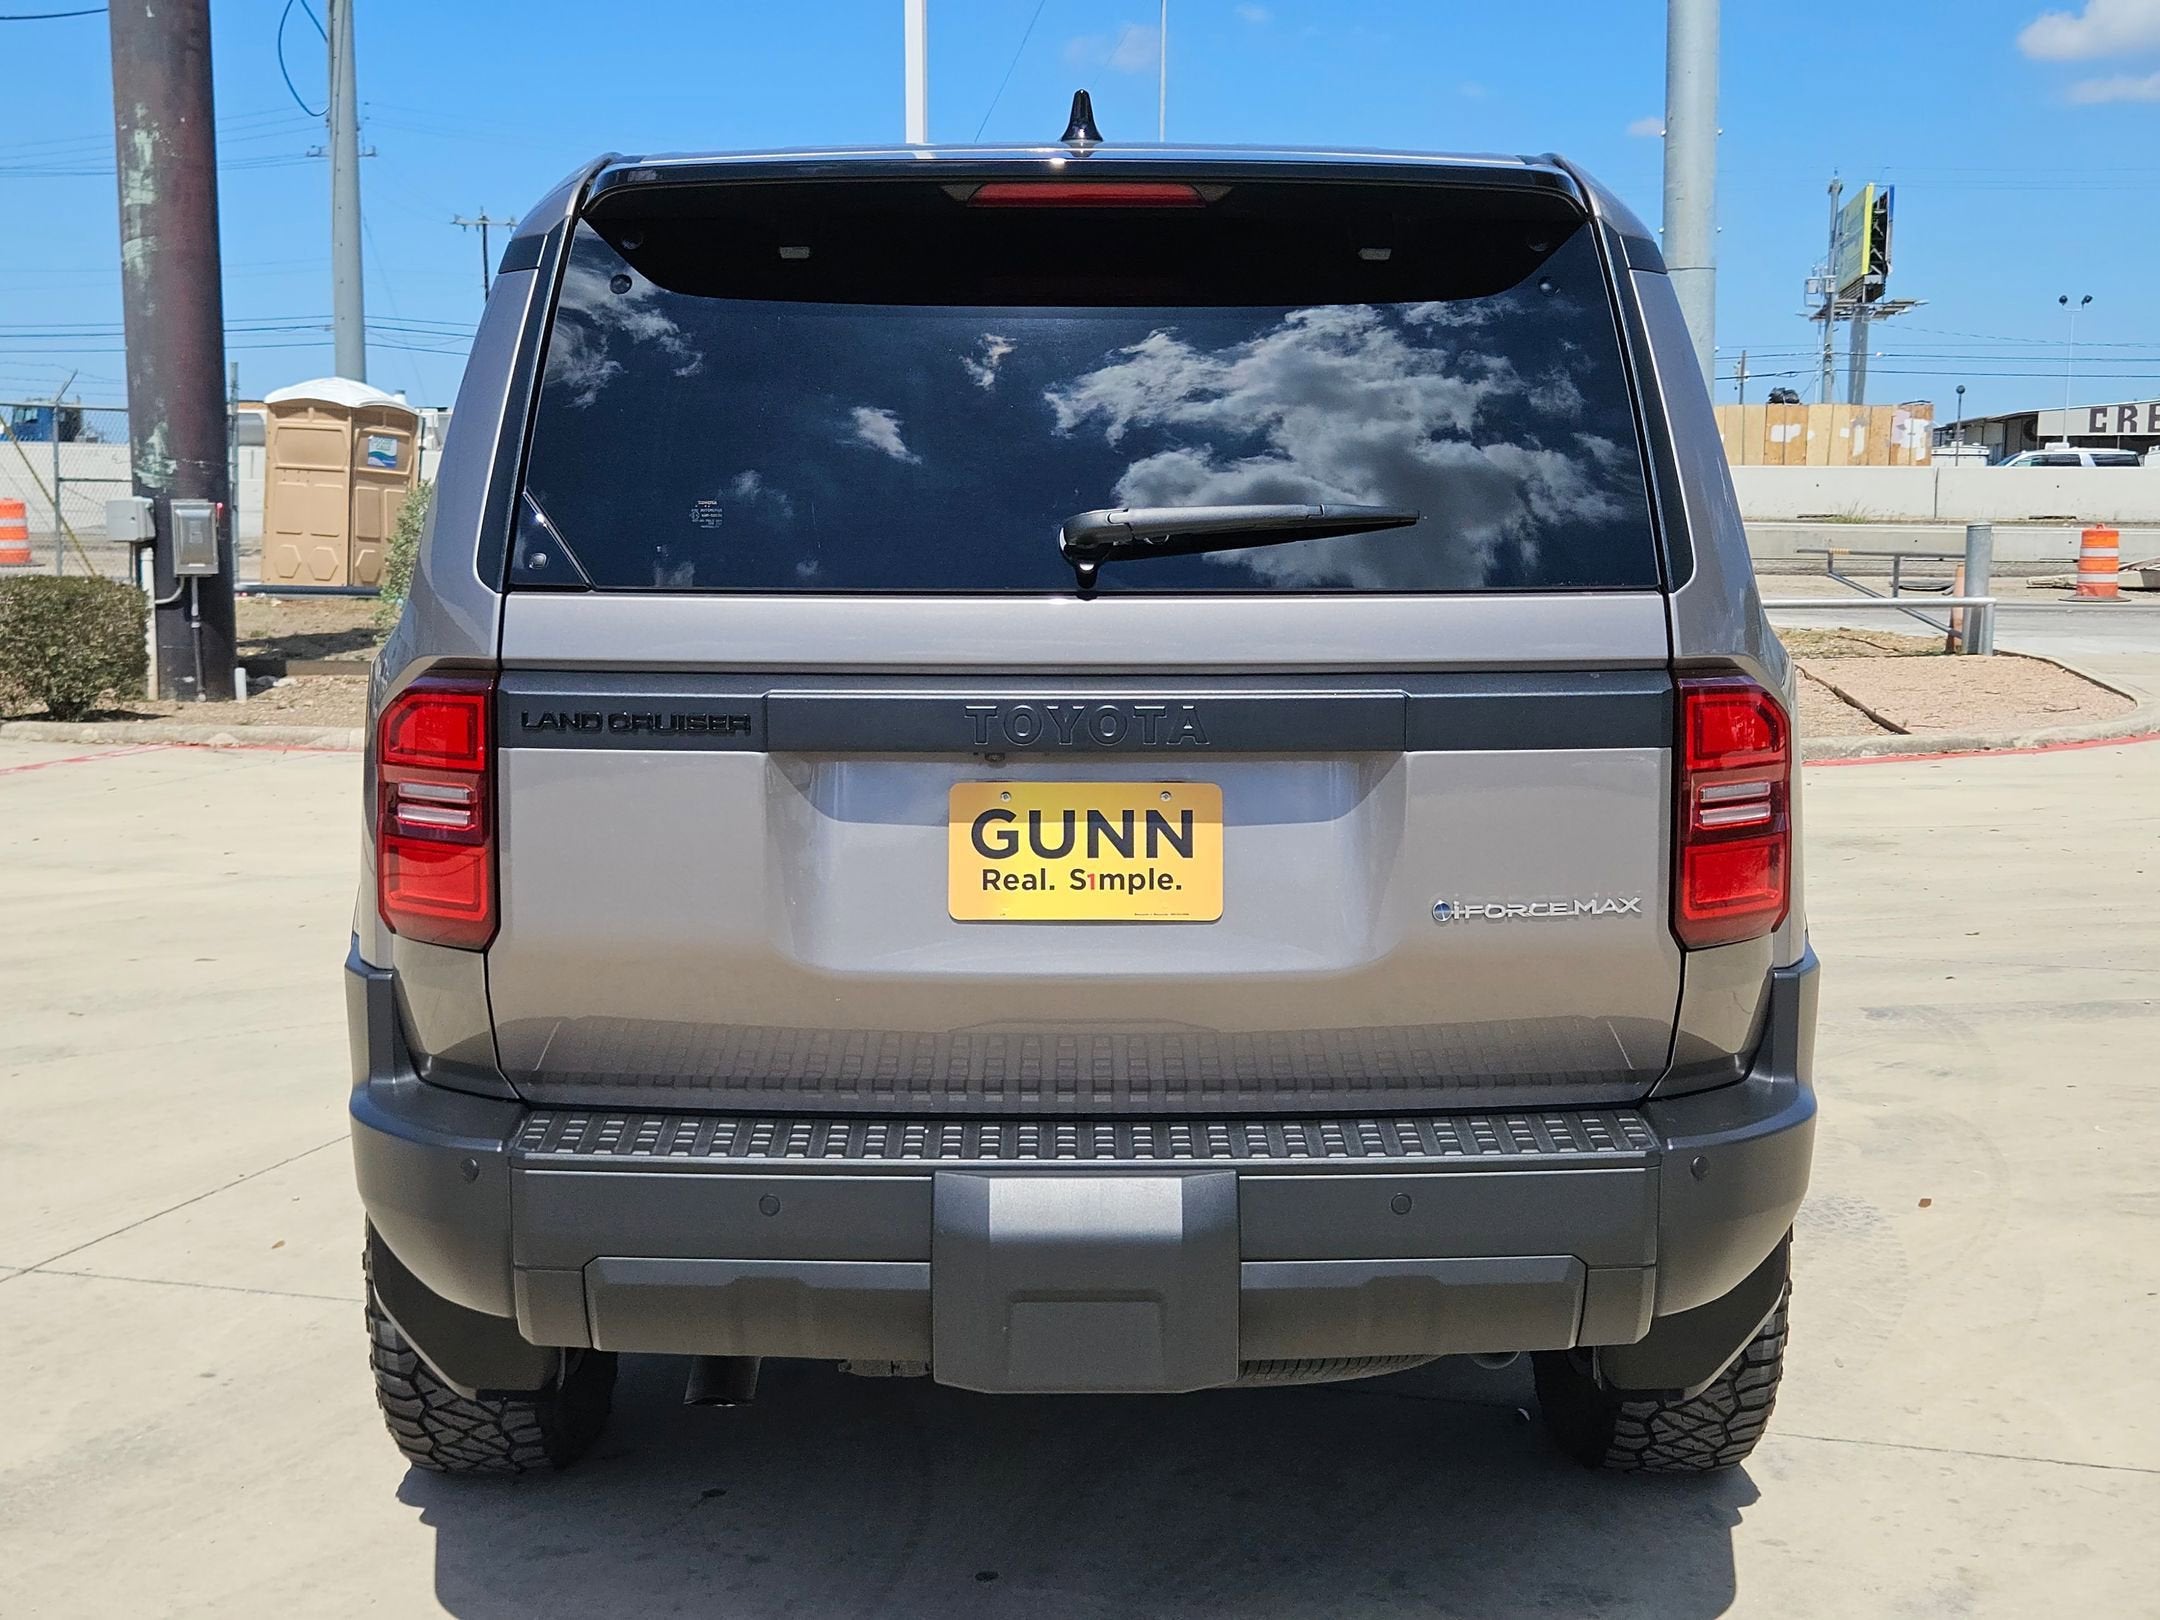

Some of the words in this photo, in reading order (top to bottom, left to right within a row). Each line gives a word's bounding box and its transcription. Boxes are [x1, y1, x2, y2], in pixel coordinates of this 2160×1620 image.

[521, 711, 603, 732] LAND
[607, 712, 751, 736] CRUISER
[964, 705, 1210, 746] TOYOTA
[971, 808, 1194, 859] GUNN
[982, 868, 1055, 891] Real.
